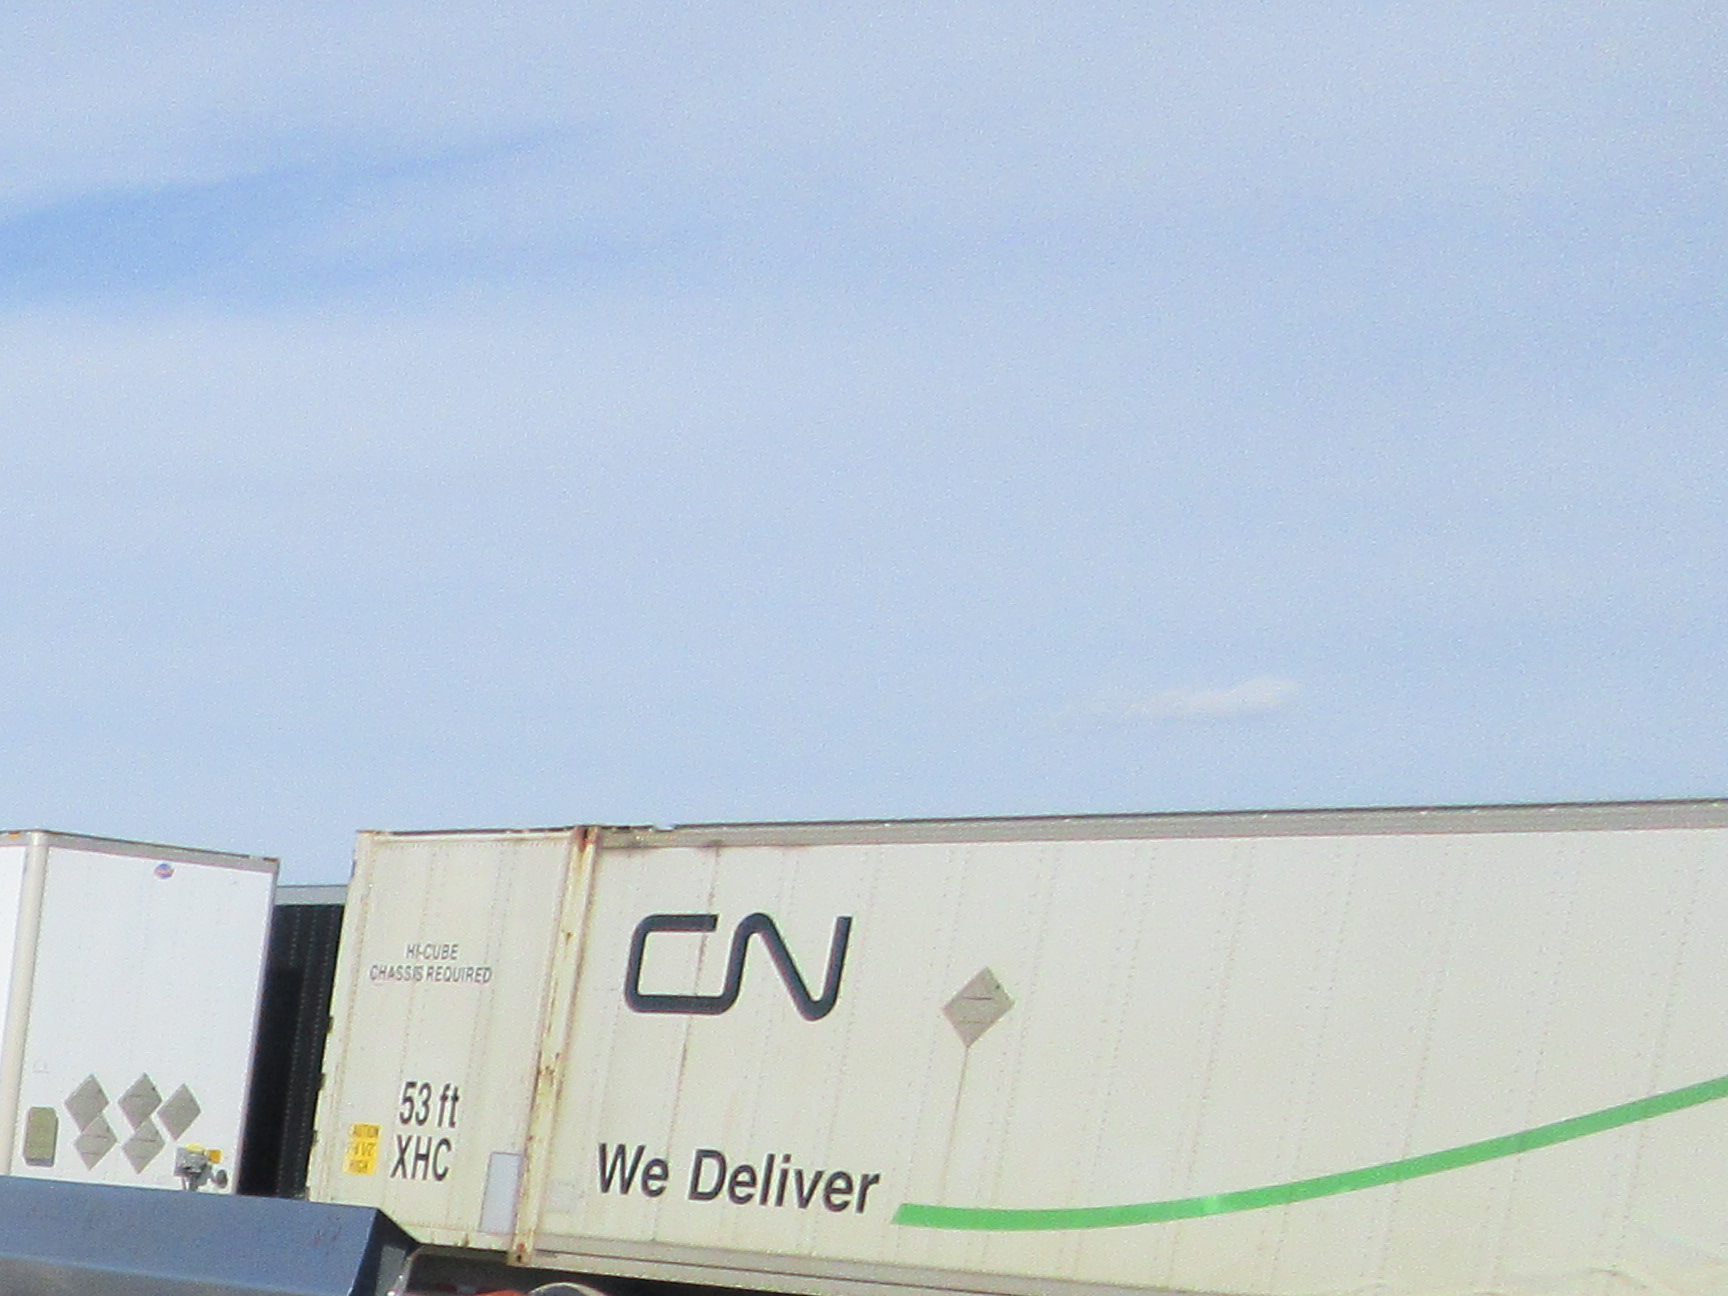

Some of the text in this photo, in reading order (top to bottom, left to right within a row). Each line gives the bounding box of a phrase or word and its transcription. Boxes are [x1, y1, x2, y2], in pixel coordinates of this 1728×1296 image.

[369, 964, 493, 984] CHASSIS REQUIRED
[405, 943, 459, 961] HI-CUBE
[624, 912, 853, 1023] CN
[399, 1081, 461, 1129] 53 ft
[389, 1134, 452, 1182] XHC
[598, 1142, 881, 1215] We Deliver
